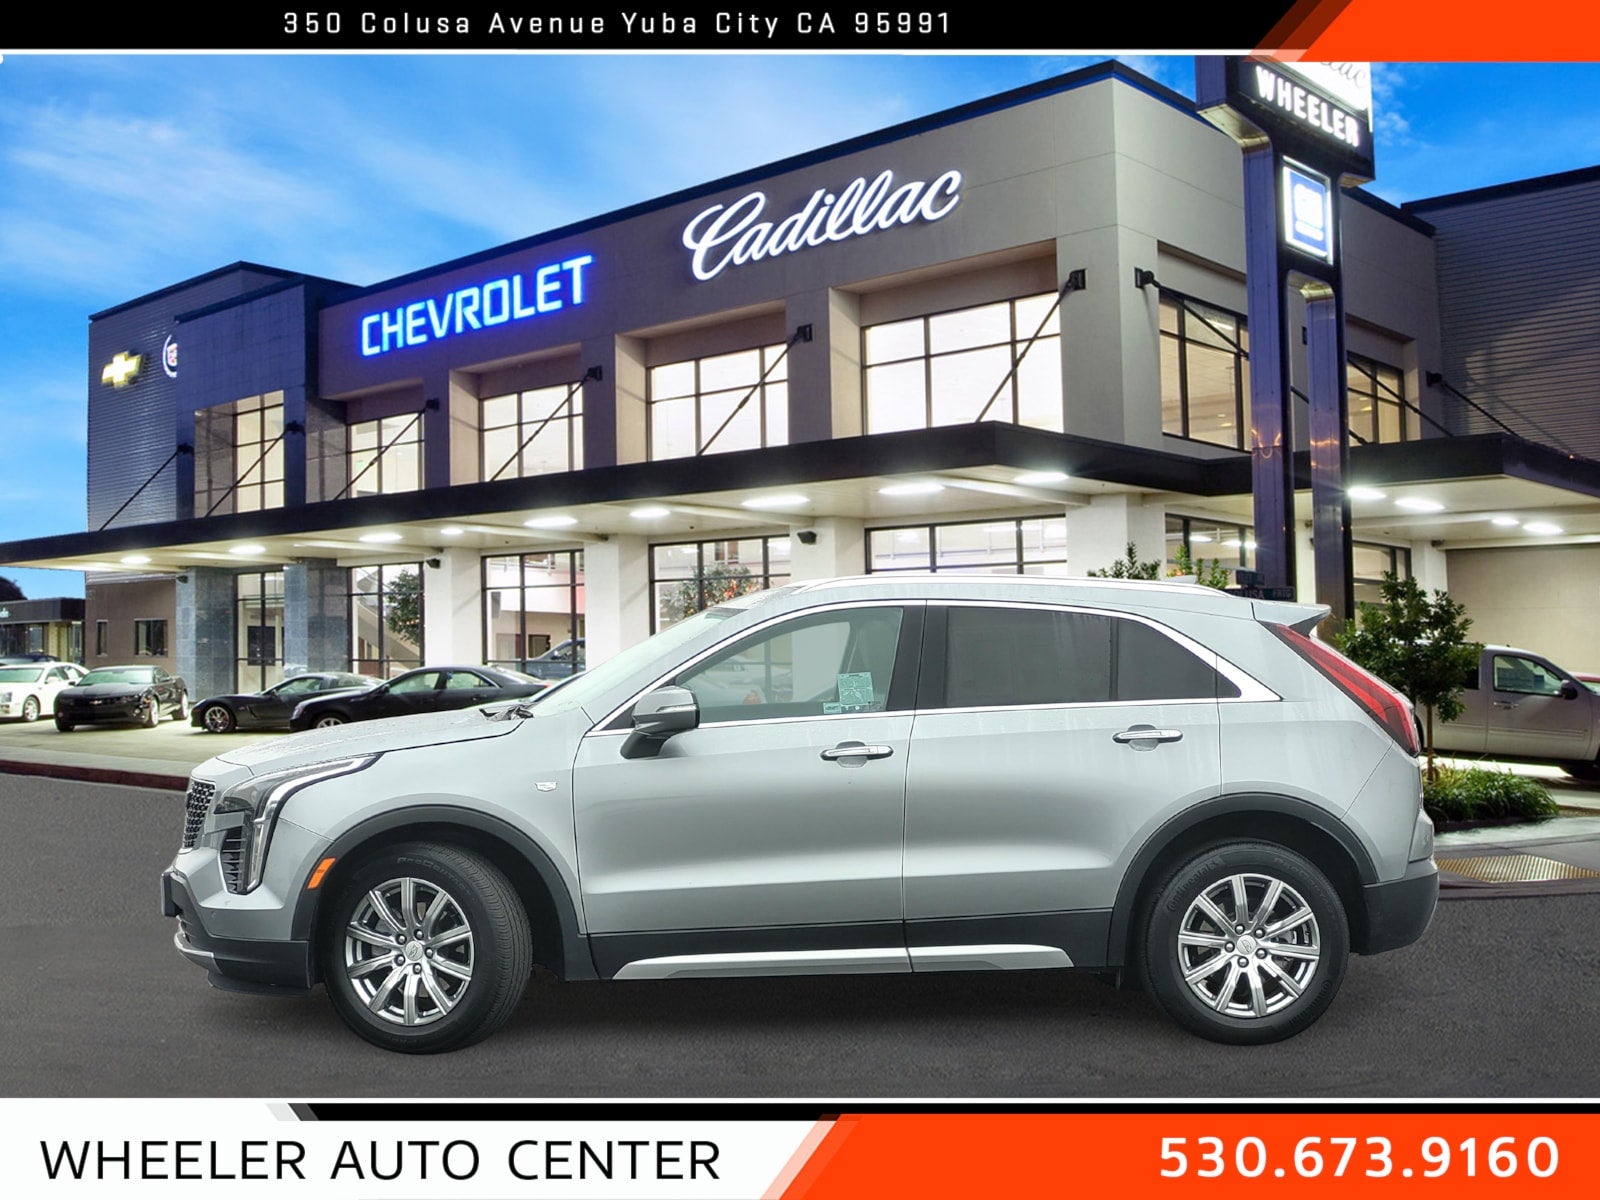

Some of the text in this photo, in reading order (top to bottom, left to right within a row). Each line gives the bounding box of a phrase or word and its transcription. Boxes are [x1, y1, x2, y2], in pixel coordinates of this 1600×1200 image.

[1256, 65, 1360, 147] WHEELER
[682, 169, 962, 281] Cadillac
[361, 254, 593, 357] CHEVROLET
